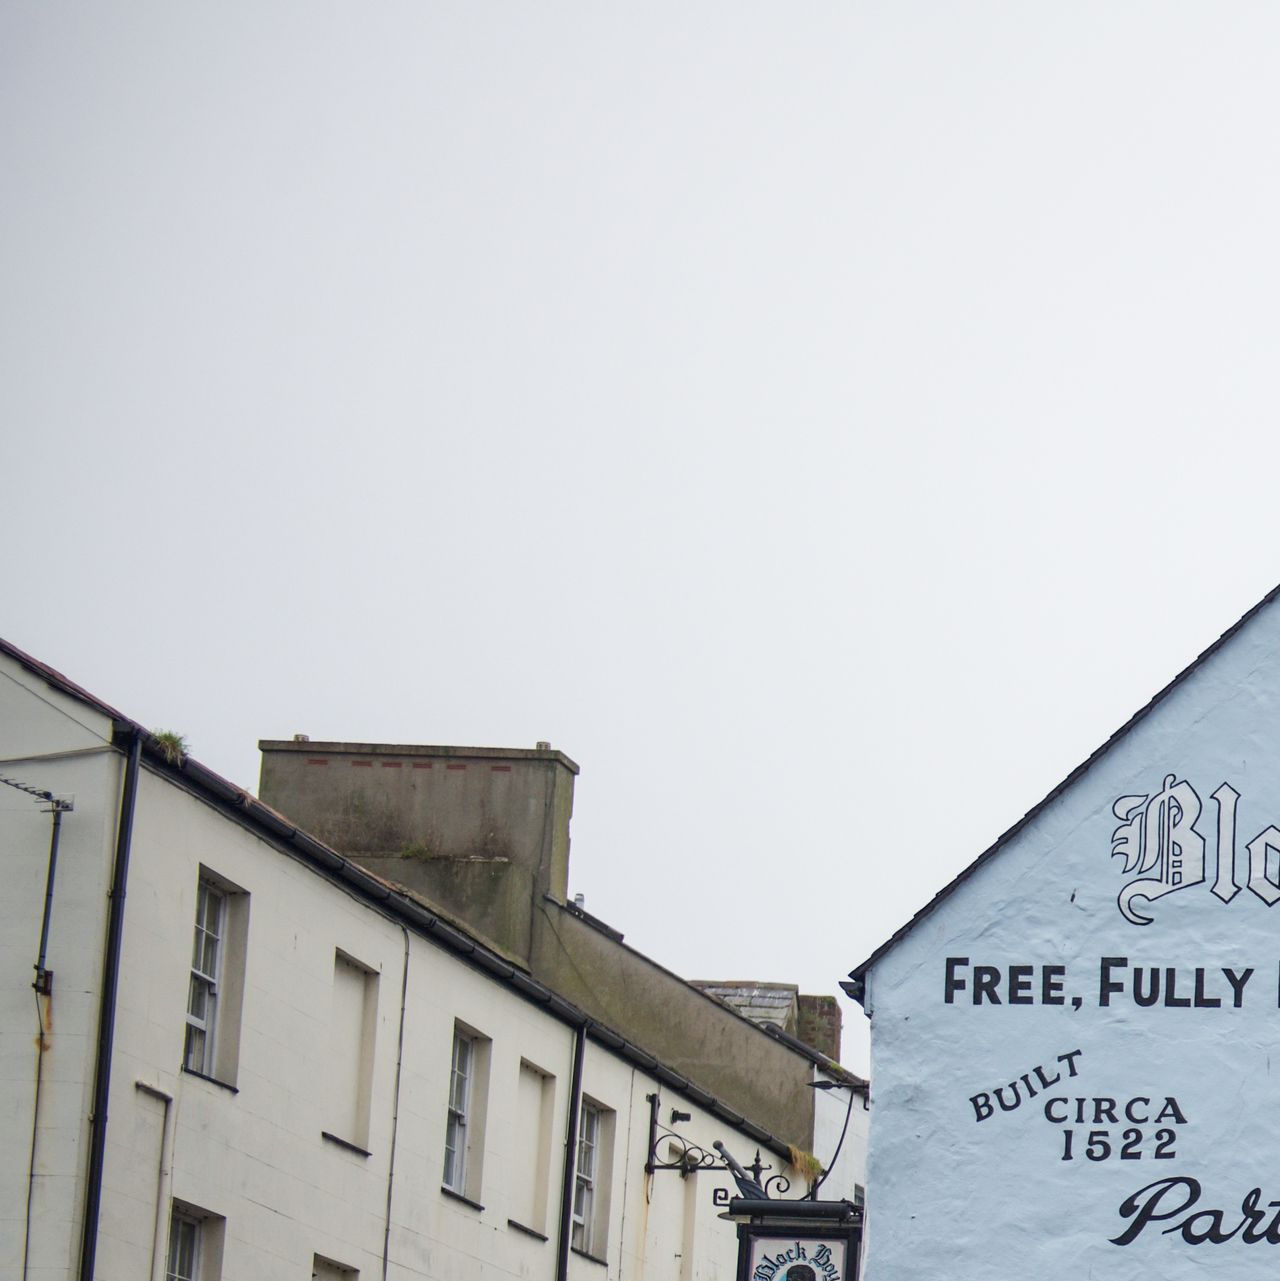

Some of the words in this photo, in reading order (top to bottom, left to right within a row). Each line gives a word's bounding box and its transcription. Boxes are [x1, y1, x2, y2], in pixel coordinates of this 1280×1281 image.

[945, 958, 1083, 1012] FREE,
[1099, 957, 1255, 1008] FULLY
[969, 1049, 1082, 1123] BUILT
[1044, 1096, 1188, 1124] CIRCA
[1062, 1128, 1177, 1161] 1522
